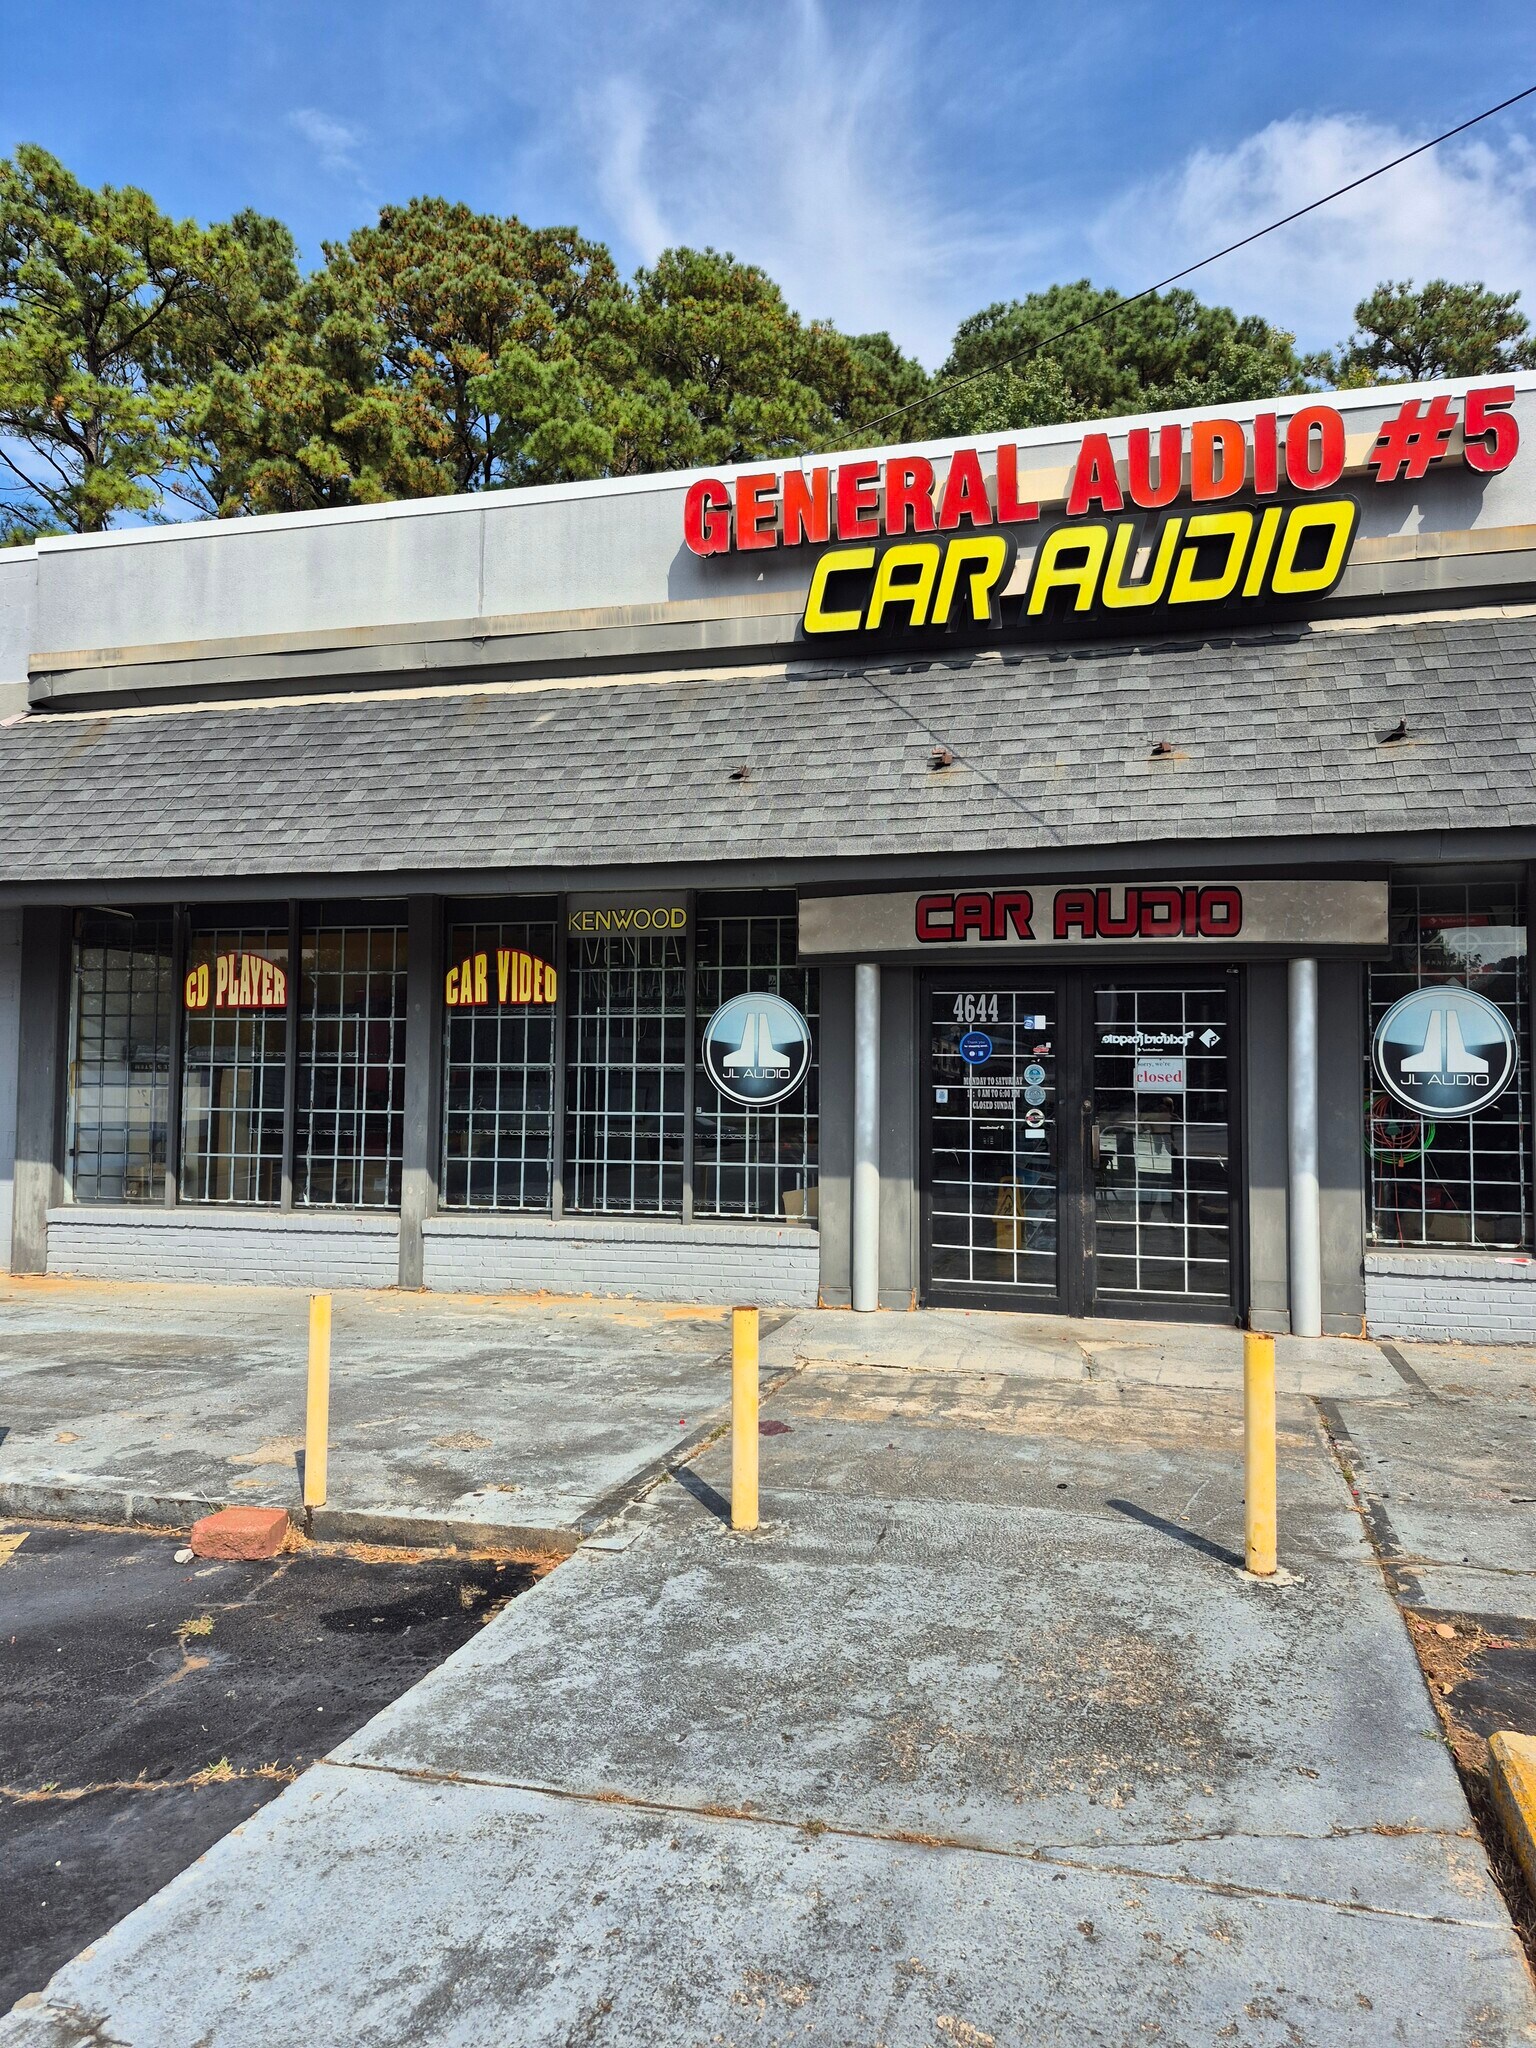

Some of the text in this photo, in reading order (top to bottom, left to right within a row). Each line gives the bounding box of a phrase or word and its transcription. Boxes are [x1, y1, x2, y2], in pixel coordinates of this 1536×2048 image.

[683, 384, 1520, 557] GENERAL AUDIO #5
[803, 499, 1356, 634] CAR AUDIO
[568, 907, 687, 931] KENWOOD
[916, 886, 1243, 943] CAR AUDIO
[186, 952, 286, 1009] CD PLAYER
[445, 948, 558, 1006] CAR VIDEO
[953, 994, 998, 1022] 4644
[722, 1068, 791, 1079] JL AUDIO
[987, 1077, 995, 1085] TO
[995, 1077, 1023, 1086] SATURAY
[1136, 1070, 1182, 1083] closed
[1400, 1073, 1490, 1086] JL AUDIO
[972, 1101, 1015, 1110] CLOSED SUNDAY
[981, 1089, 991, 1098] AM
[991, 1089, 999, 1098] TO
